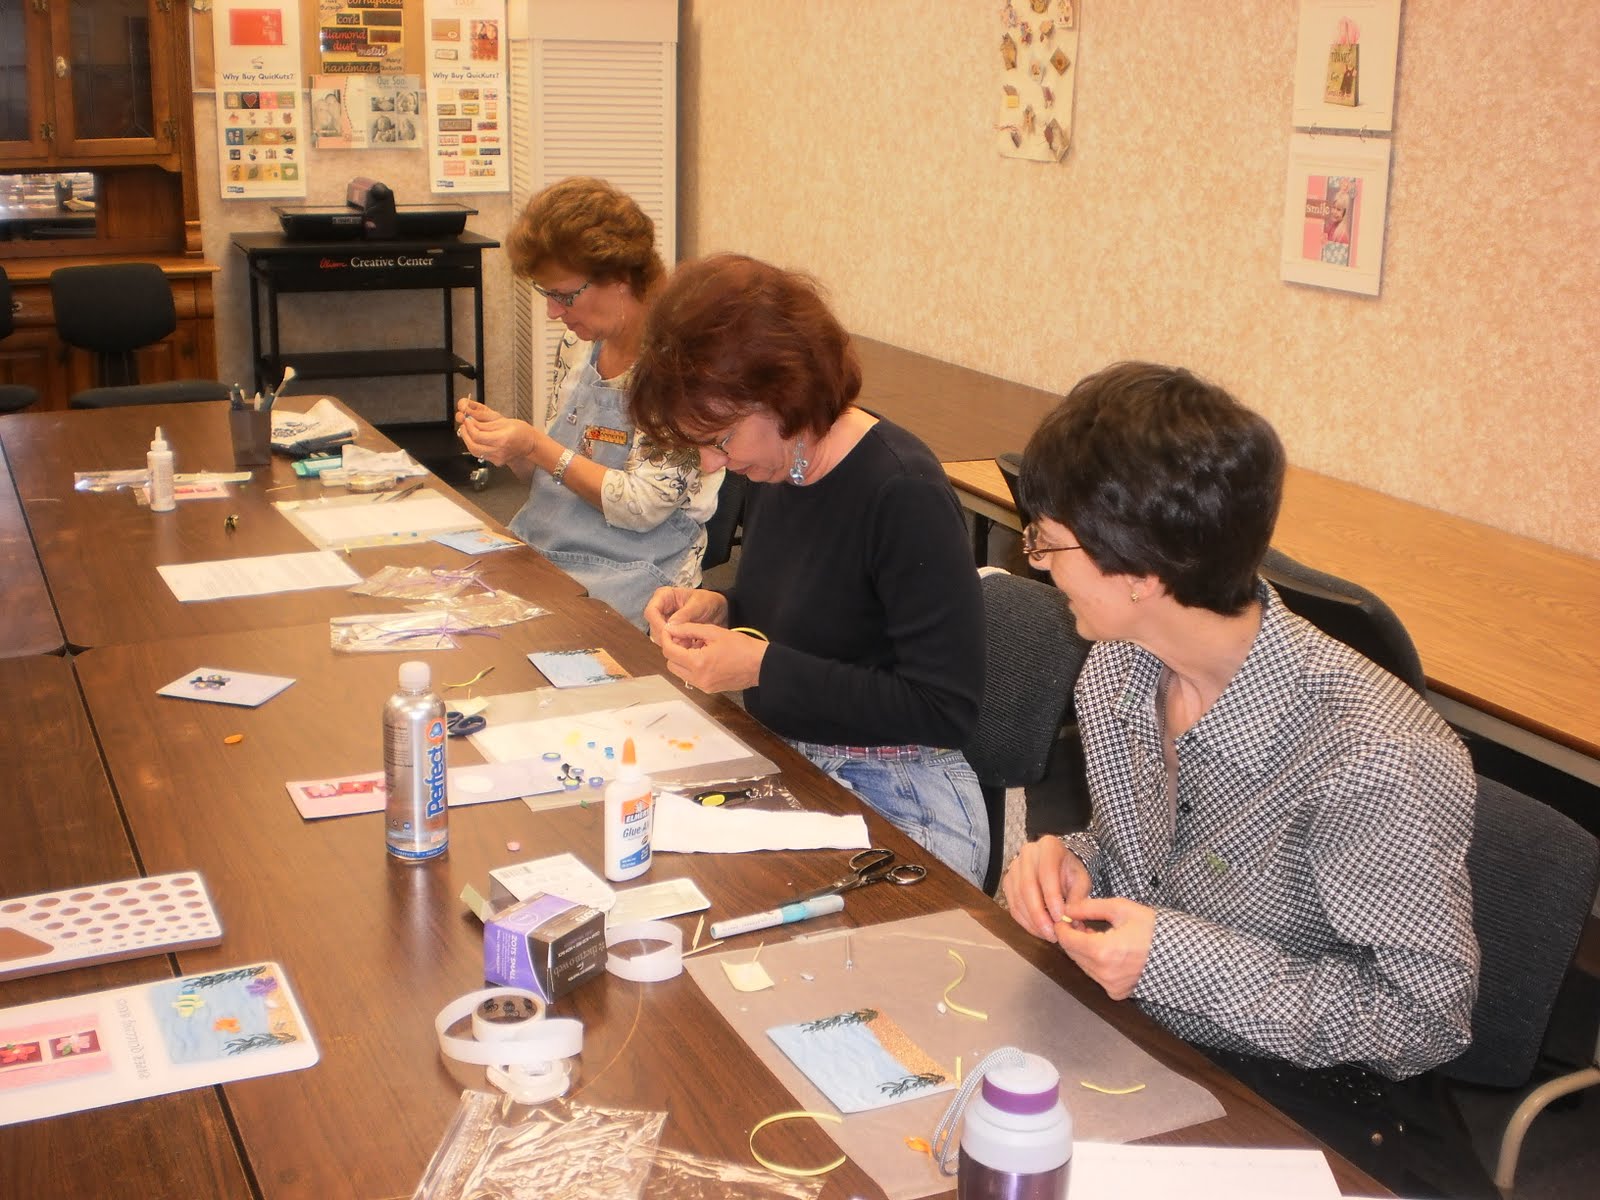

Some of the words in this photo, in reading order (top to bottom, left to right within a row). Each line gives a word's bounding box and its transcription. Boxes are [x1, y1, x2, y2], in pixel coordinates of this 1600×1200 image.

[337, 15, 359, 24] cork
[223, 73, 240, 81] Why
[242, 73, 256, 81] Buy
[433, 72, 449, 80] Why
[451, 72, 464, 80] Buy
[1305, 202, 1330, 216] smile
[350, 256, 394, 268] Creative
[397, 256, 434, 267] Center
[423, 744, 444, 820] Perfect
[510, 934, 518, 955] ZOTS
[509, 957, 517, 981] SMALL
